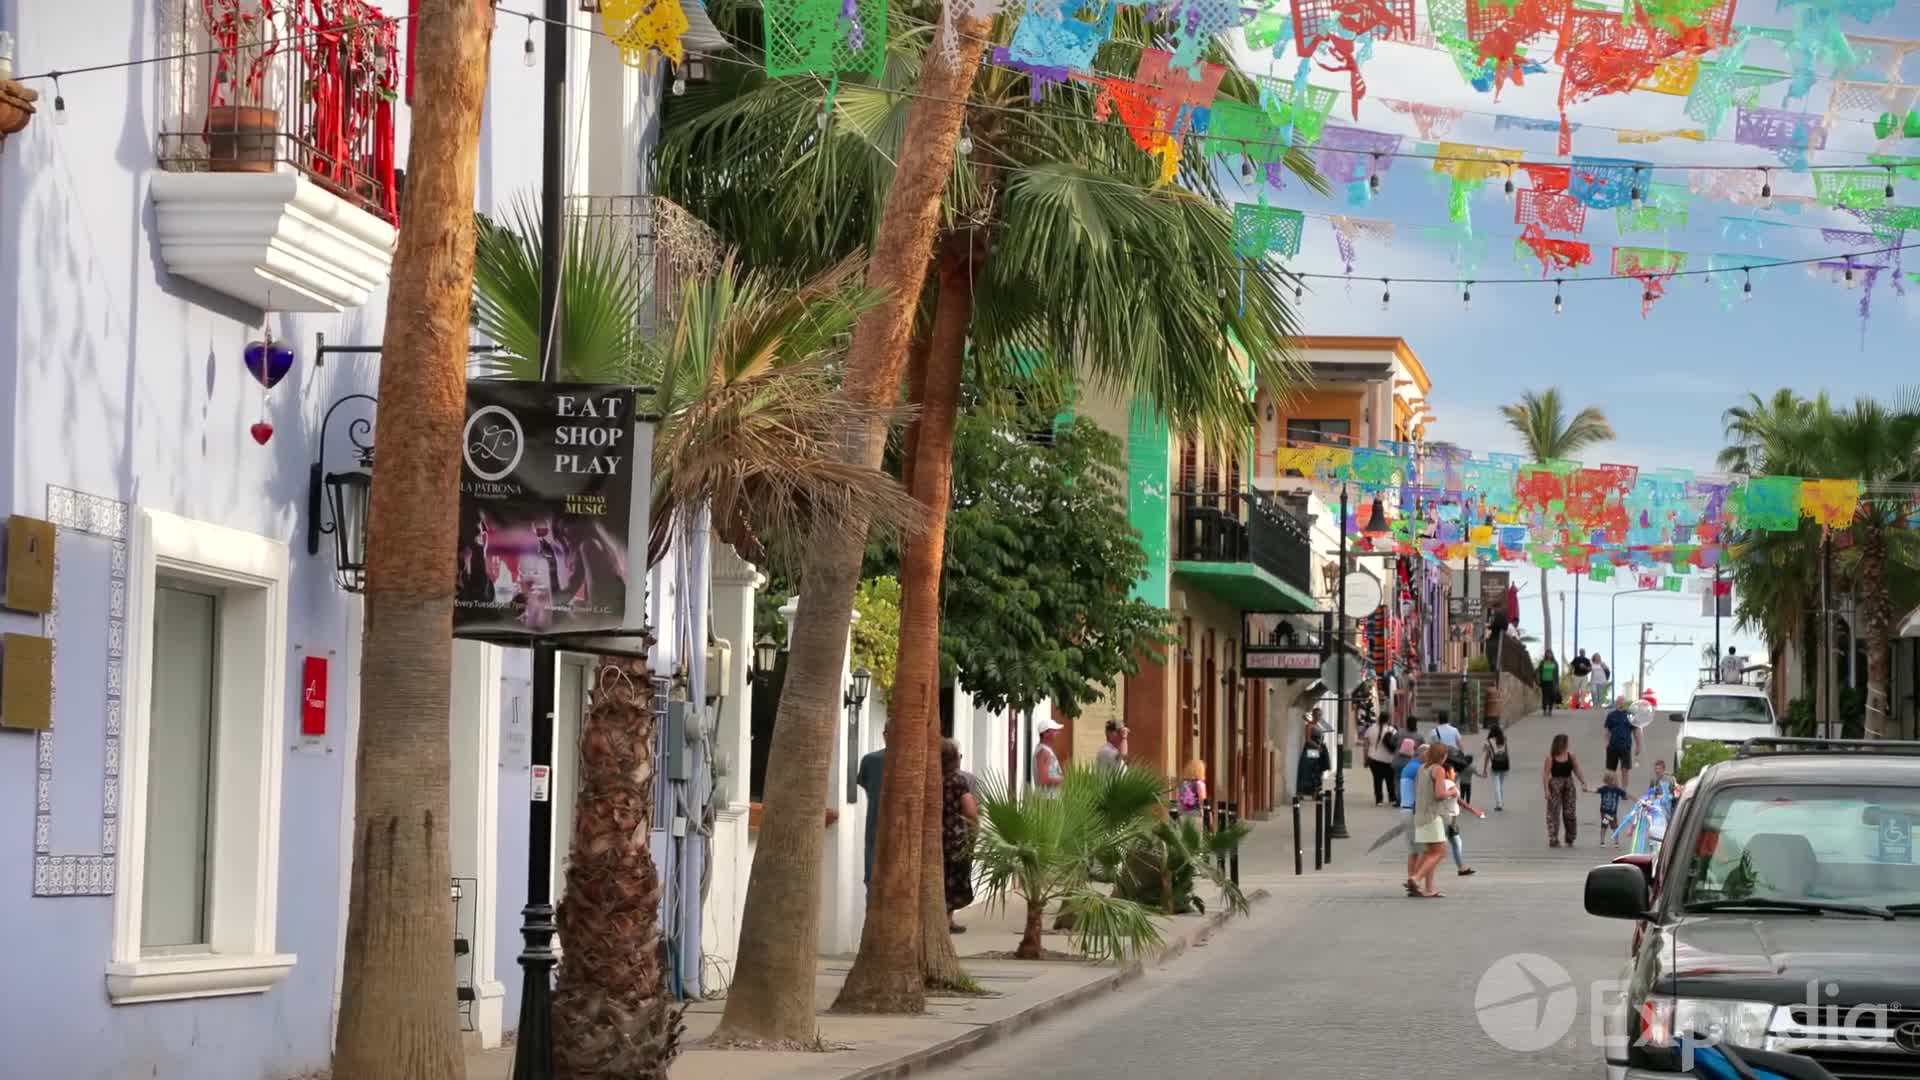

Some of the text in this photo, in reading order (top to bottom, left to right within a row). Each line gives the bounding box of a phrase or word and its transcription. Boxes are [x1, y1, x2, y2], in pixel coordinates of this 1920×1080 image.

[556, 396, 622, 418] EAT
[555, 426, 623, 446] SHOP
[553, 454, 622, 475] PLAY
[474, 483, 522, 495] PATRONA
[566, 495, 606, 503] TUESDAY
[565, 503, 607, 514] MUSIC
